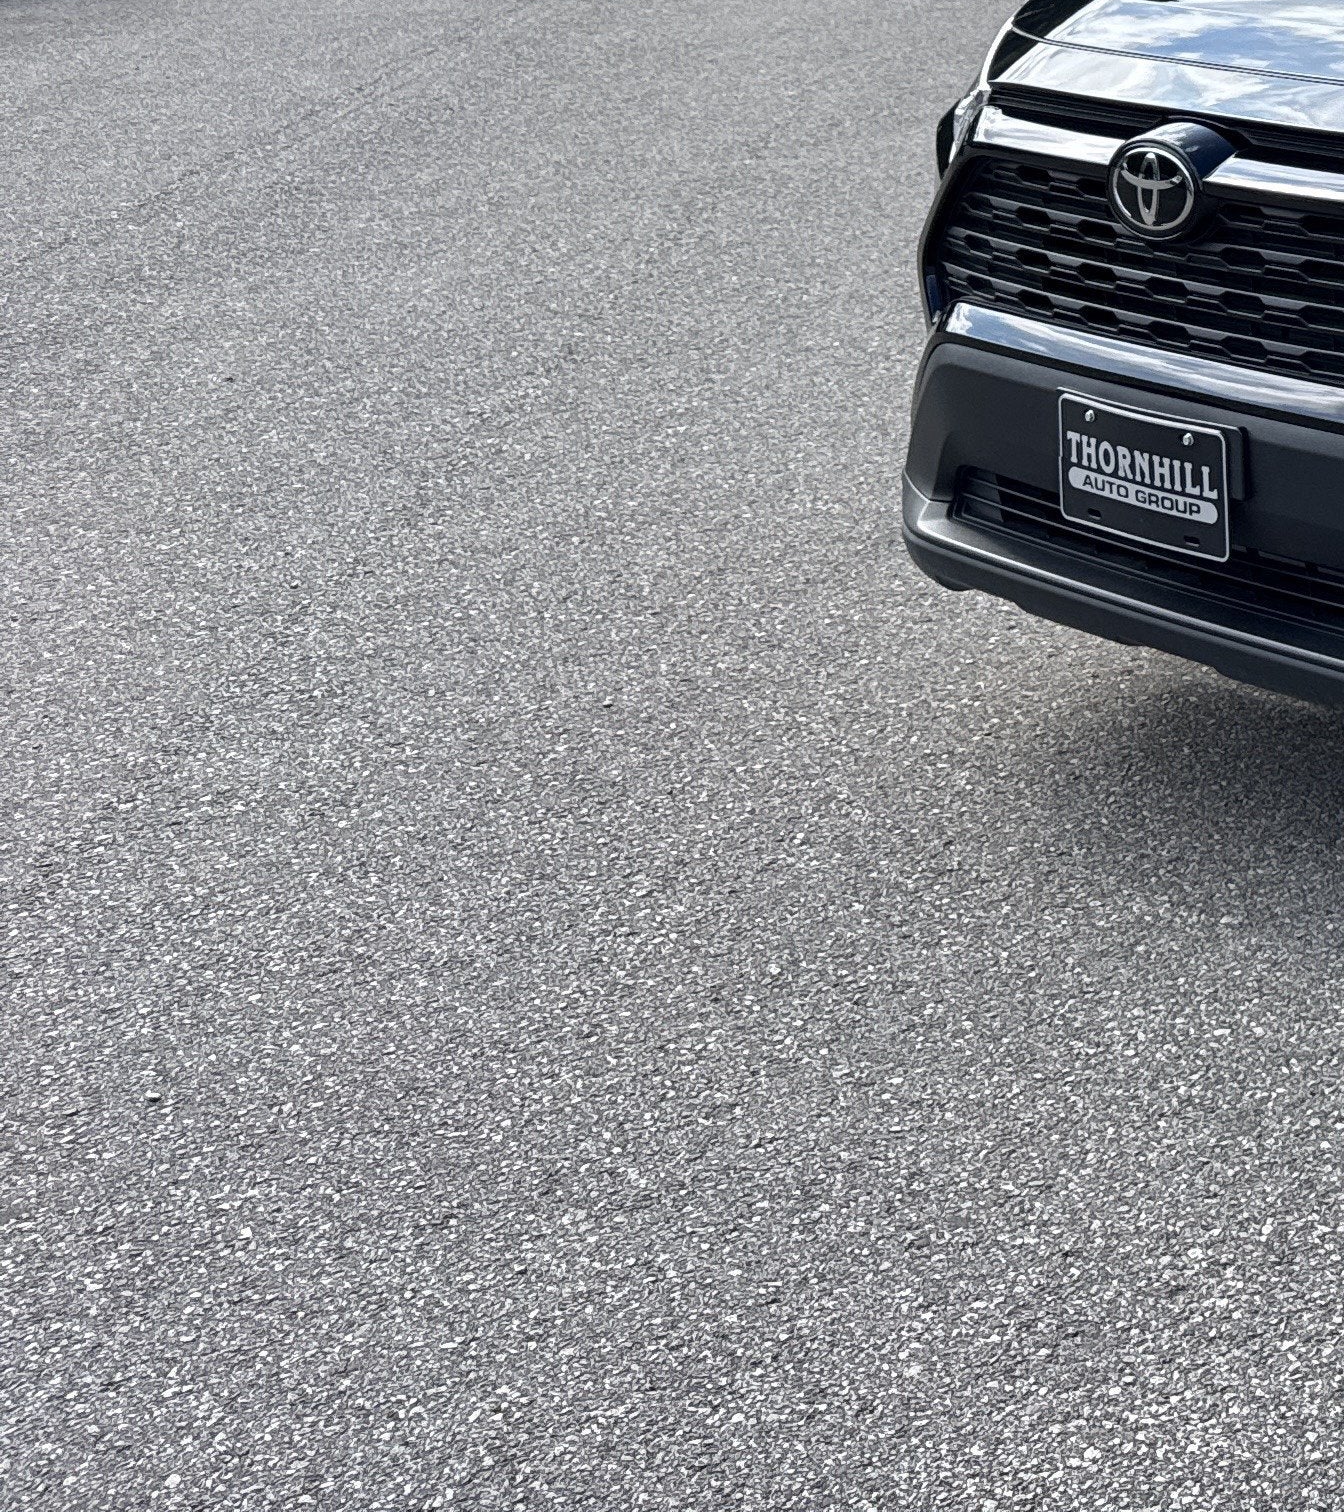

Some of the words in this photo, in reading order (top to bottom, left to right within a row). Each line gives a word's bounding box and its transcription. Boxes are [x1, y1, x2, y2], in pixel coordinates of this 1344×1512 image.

[1066, 430, 1219, 500] THORNHILL
[1082, 474, 1129, 499] AUTO
[1134, 489, 1201, 517] GROUP
